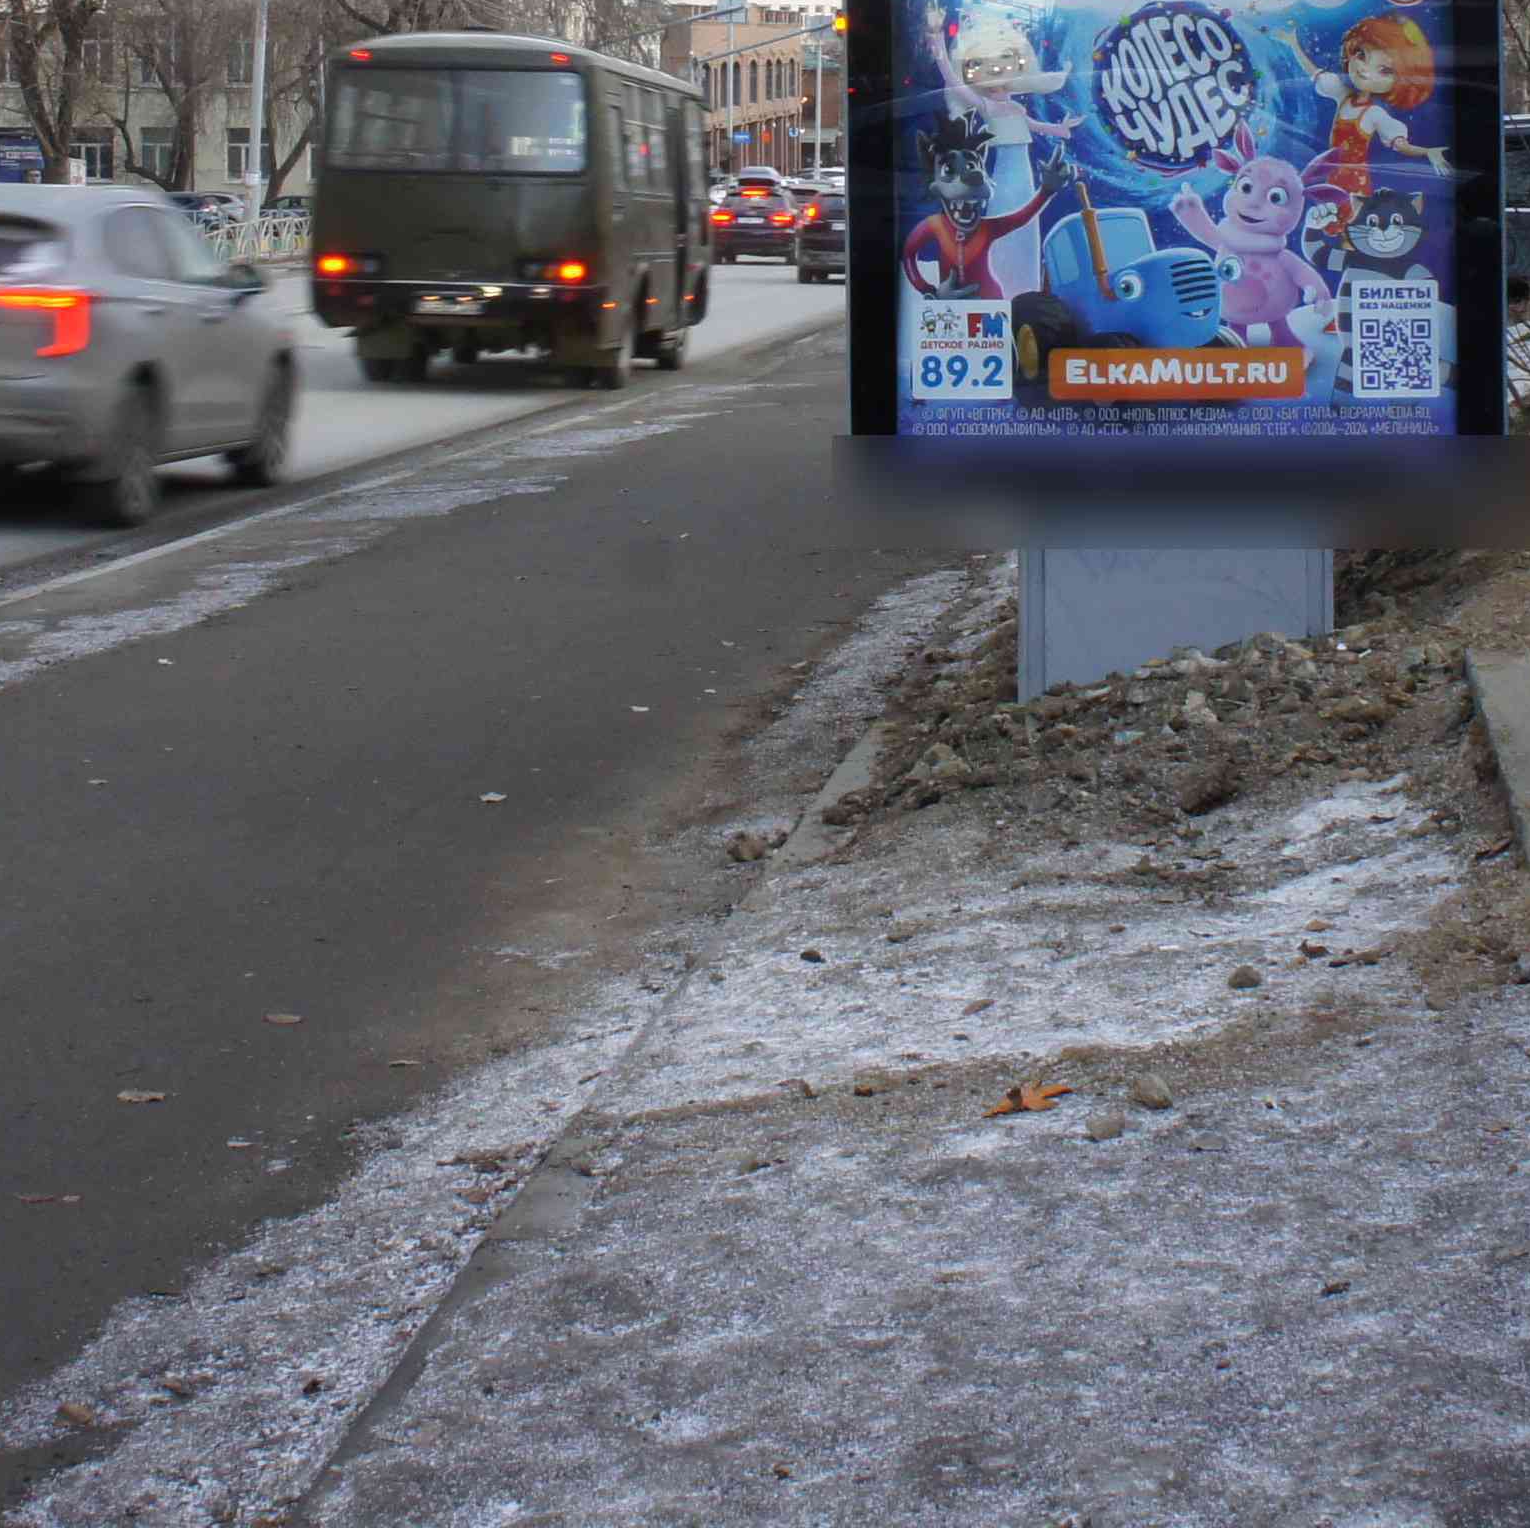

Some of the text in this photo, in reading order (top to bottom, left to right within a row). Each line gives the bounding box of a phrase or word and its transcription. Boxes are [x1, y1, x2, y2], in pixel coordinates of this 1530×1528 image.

[1102, 14, 1232, 114] КОЛЕСО
[1115, 60, 1249, 158] ЧУДЕС
[1359, 287, 1431, 299] БИЛЕТЫ
[1359, 302, 1431, 310] БЕЗ НАЦЕНКИ
[967, 312, 1004, 338] FM
[920, 340, 1005, 350] ДЕТСКОЕ РАДИО
[920, 355, 1005, 388] 89.2
